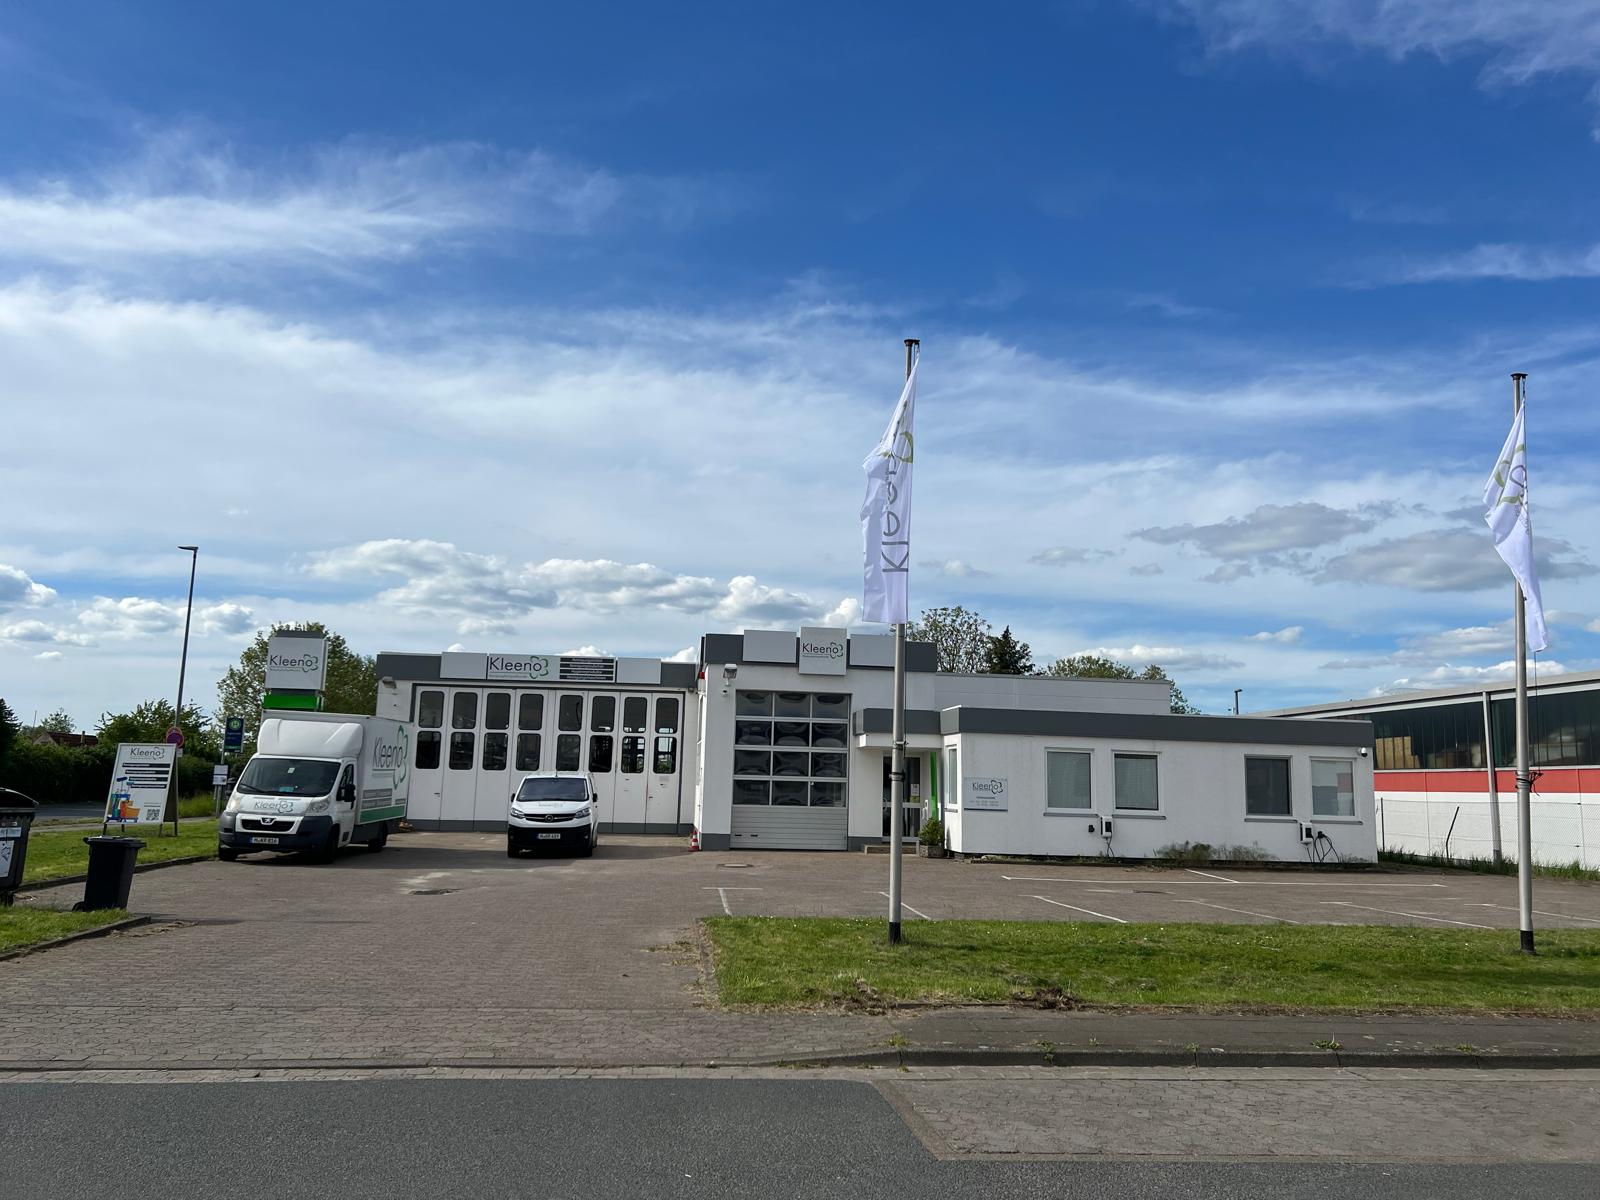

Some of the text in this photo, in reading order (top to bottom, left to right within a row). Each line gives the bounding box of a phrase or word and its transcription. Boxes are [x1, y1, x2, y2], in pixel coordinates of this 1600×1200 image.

[802, 642, 839, 654] Kleeno
[269, 654, 313, 667] Kleeno
[489, 656, 542, 672] Kleeno
[130, 747, 161, 757] Kleeno
[372, 736, 404, 769] Kleeno
[972, 781, 999, 791] Kleeno
[254, 801, 289, 810] Kleeno
